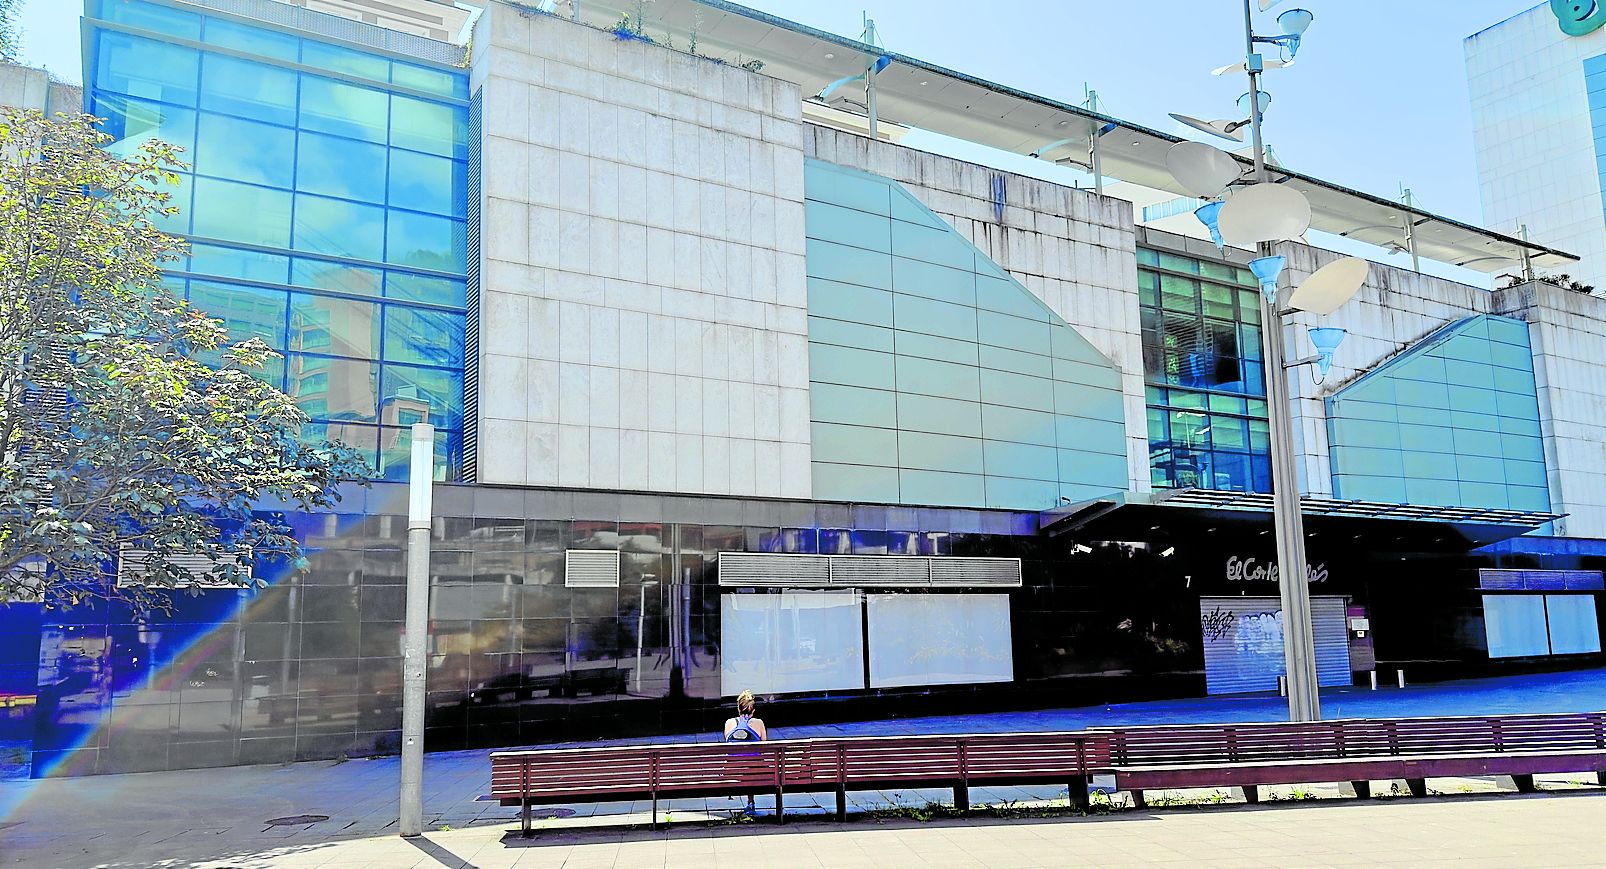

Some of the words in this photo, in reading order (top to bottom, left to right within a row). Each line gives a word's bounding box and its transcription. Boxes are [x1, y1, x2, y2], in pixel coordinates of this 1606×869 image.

[1226, 555, 1242, 581] El
[1243, 558, 1279, 582] Corte
[1184, 575, 1192, 589] 7
